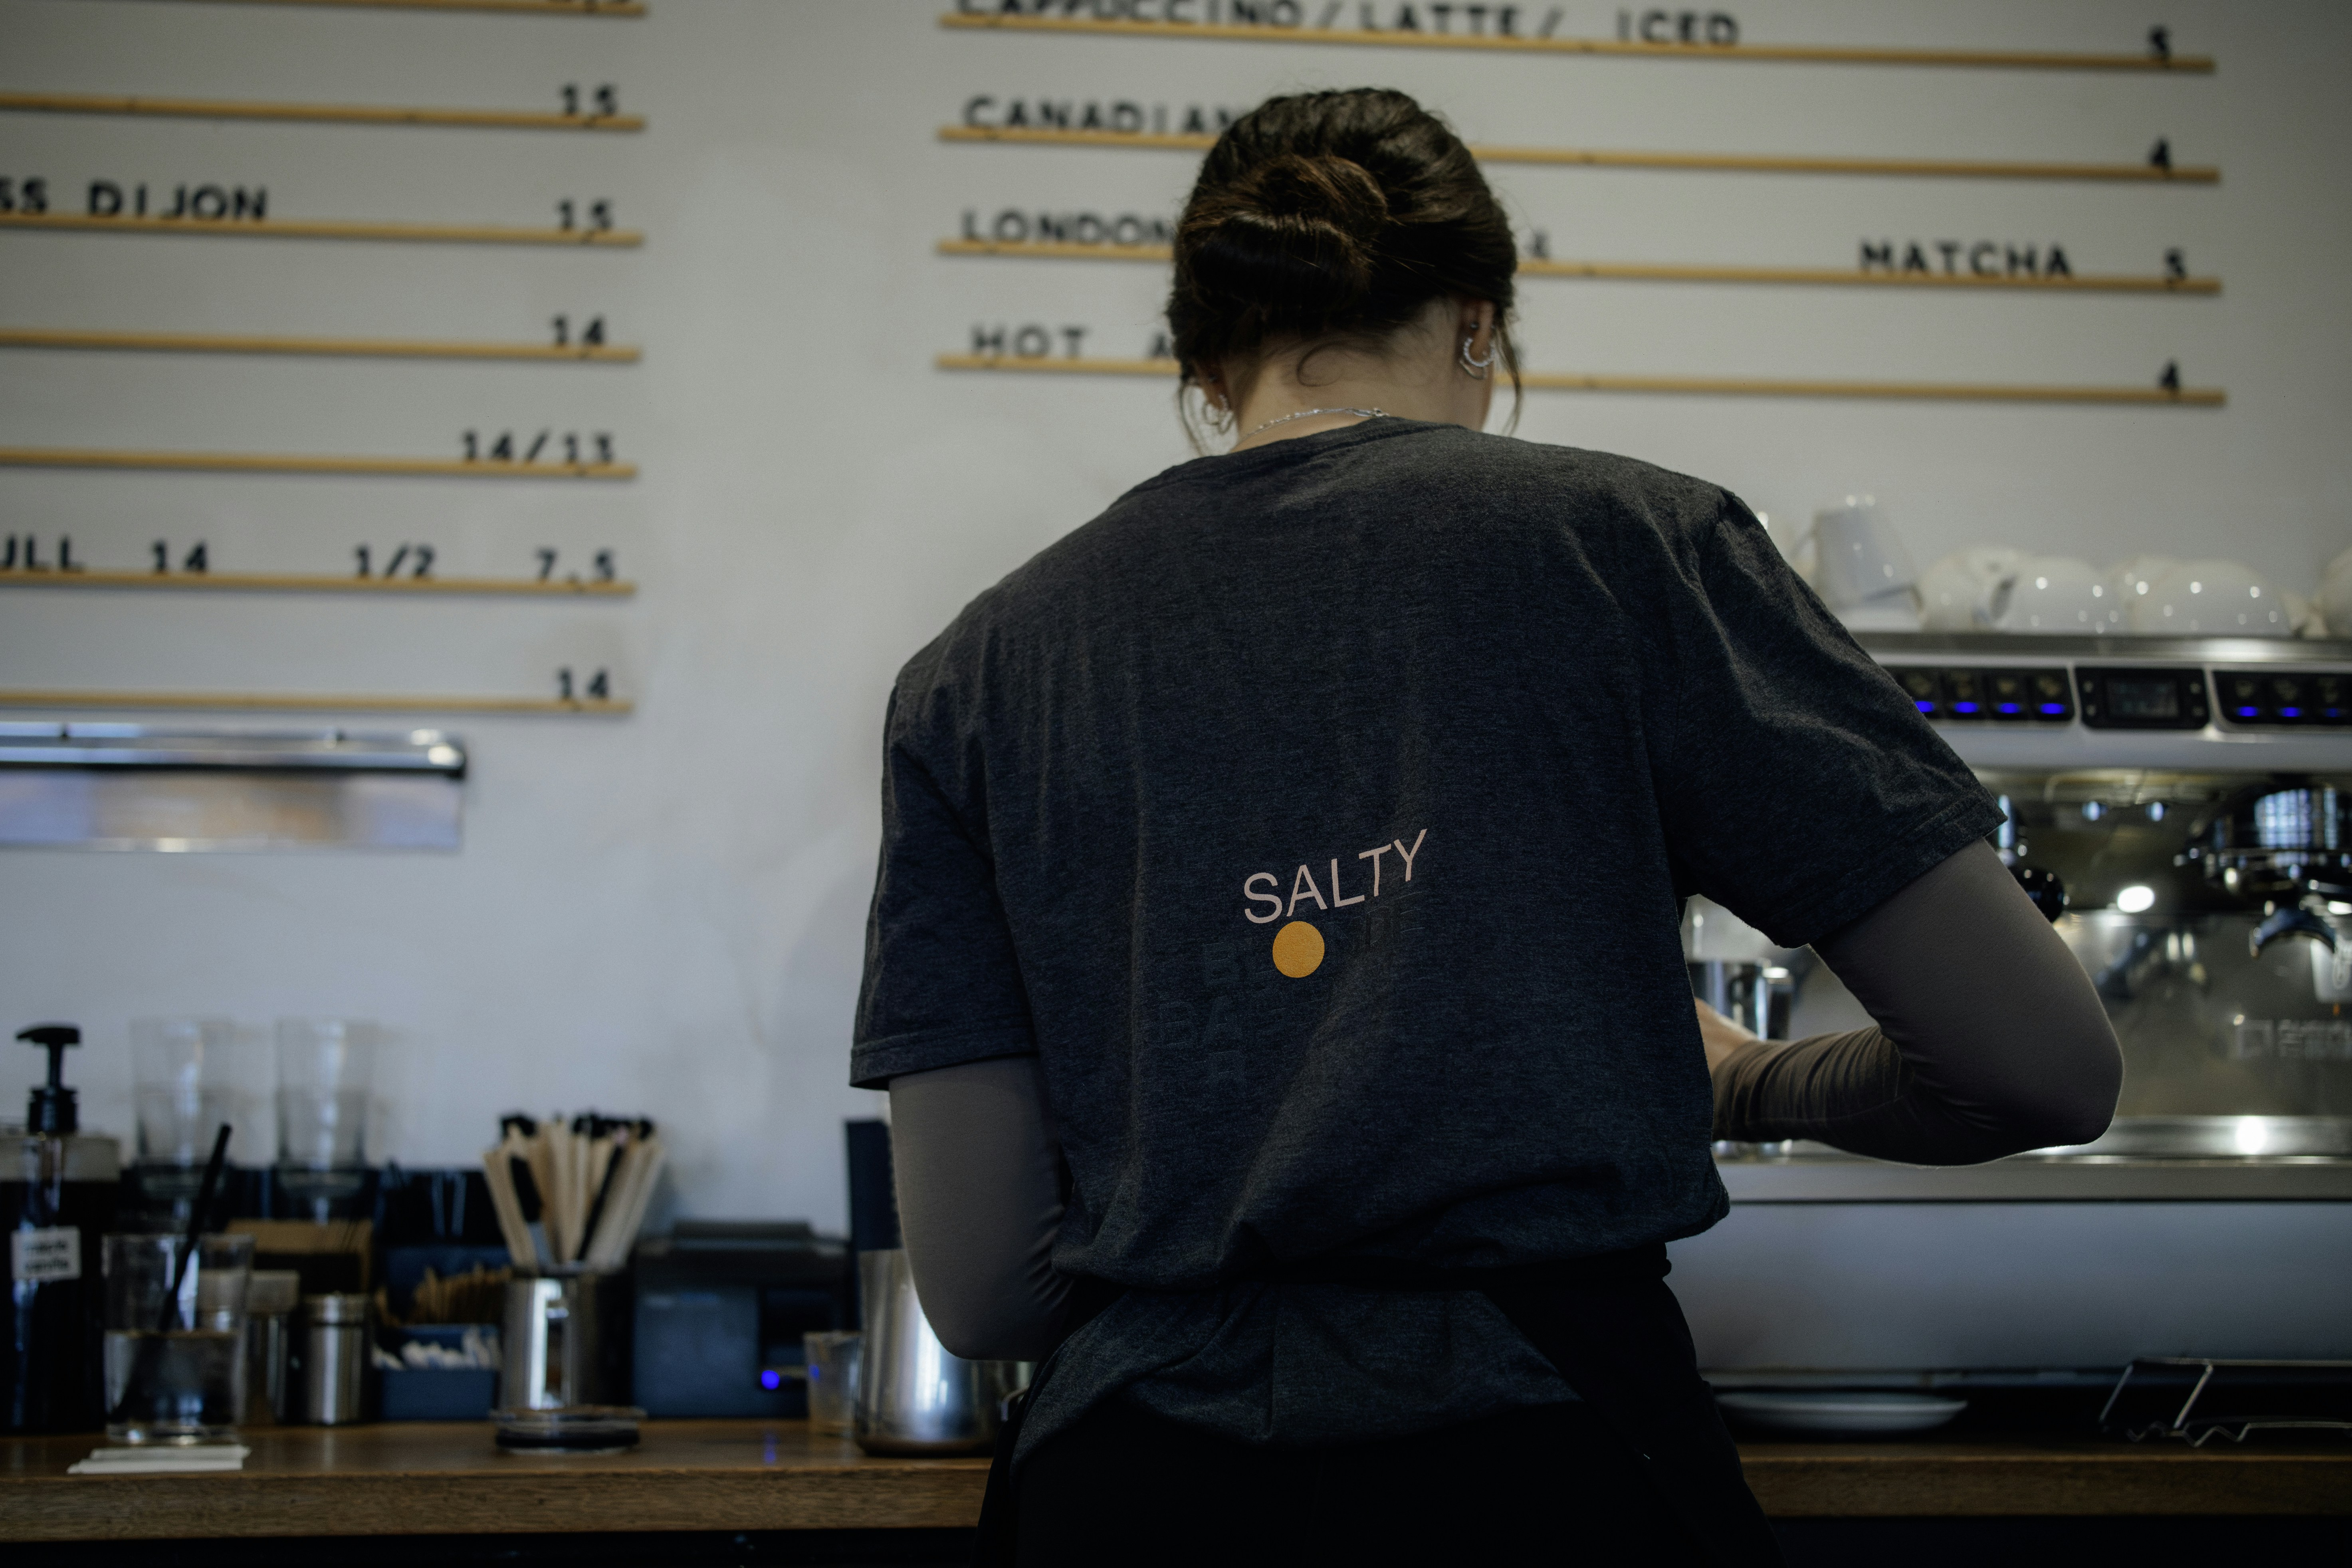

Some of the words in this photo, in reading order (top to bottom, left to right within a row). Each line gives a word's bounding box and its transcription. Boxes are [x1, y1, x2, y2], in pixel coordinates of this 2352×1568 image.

[1616, 8, 1741, 45] ICED
[2147, 138, 2173, 170] 4
[85, 179, 268, 220] DIJON
[961, 209, 1176, 244] LONDON
[1859, 240, 2074, 277] MATCHA
[552, 315, 606, 347] 14
[969, 323, 1087, 358] HOT
[2157, 361, 2183, 394] 4
[462, 430, 614, 464] 14/13
[150, 540, 209, 575] 14
[353, 544, 436, 579] 1/2
[557, 668, 610, 702] 14
[1244, 829, 1427, 924] SALTY
